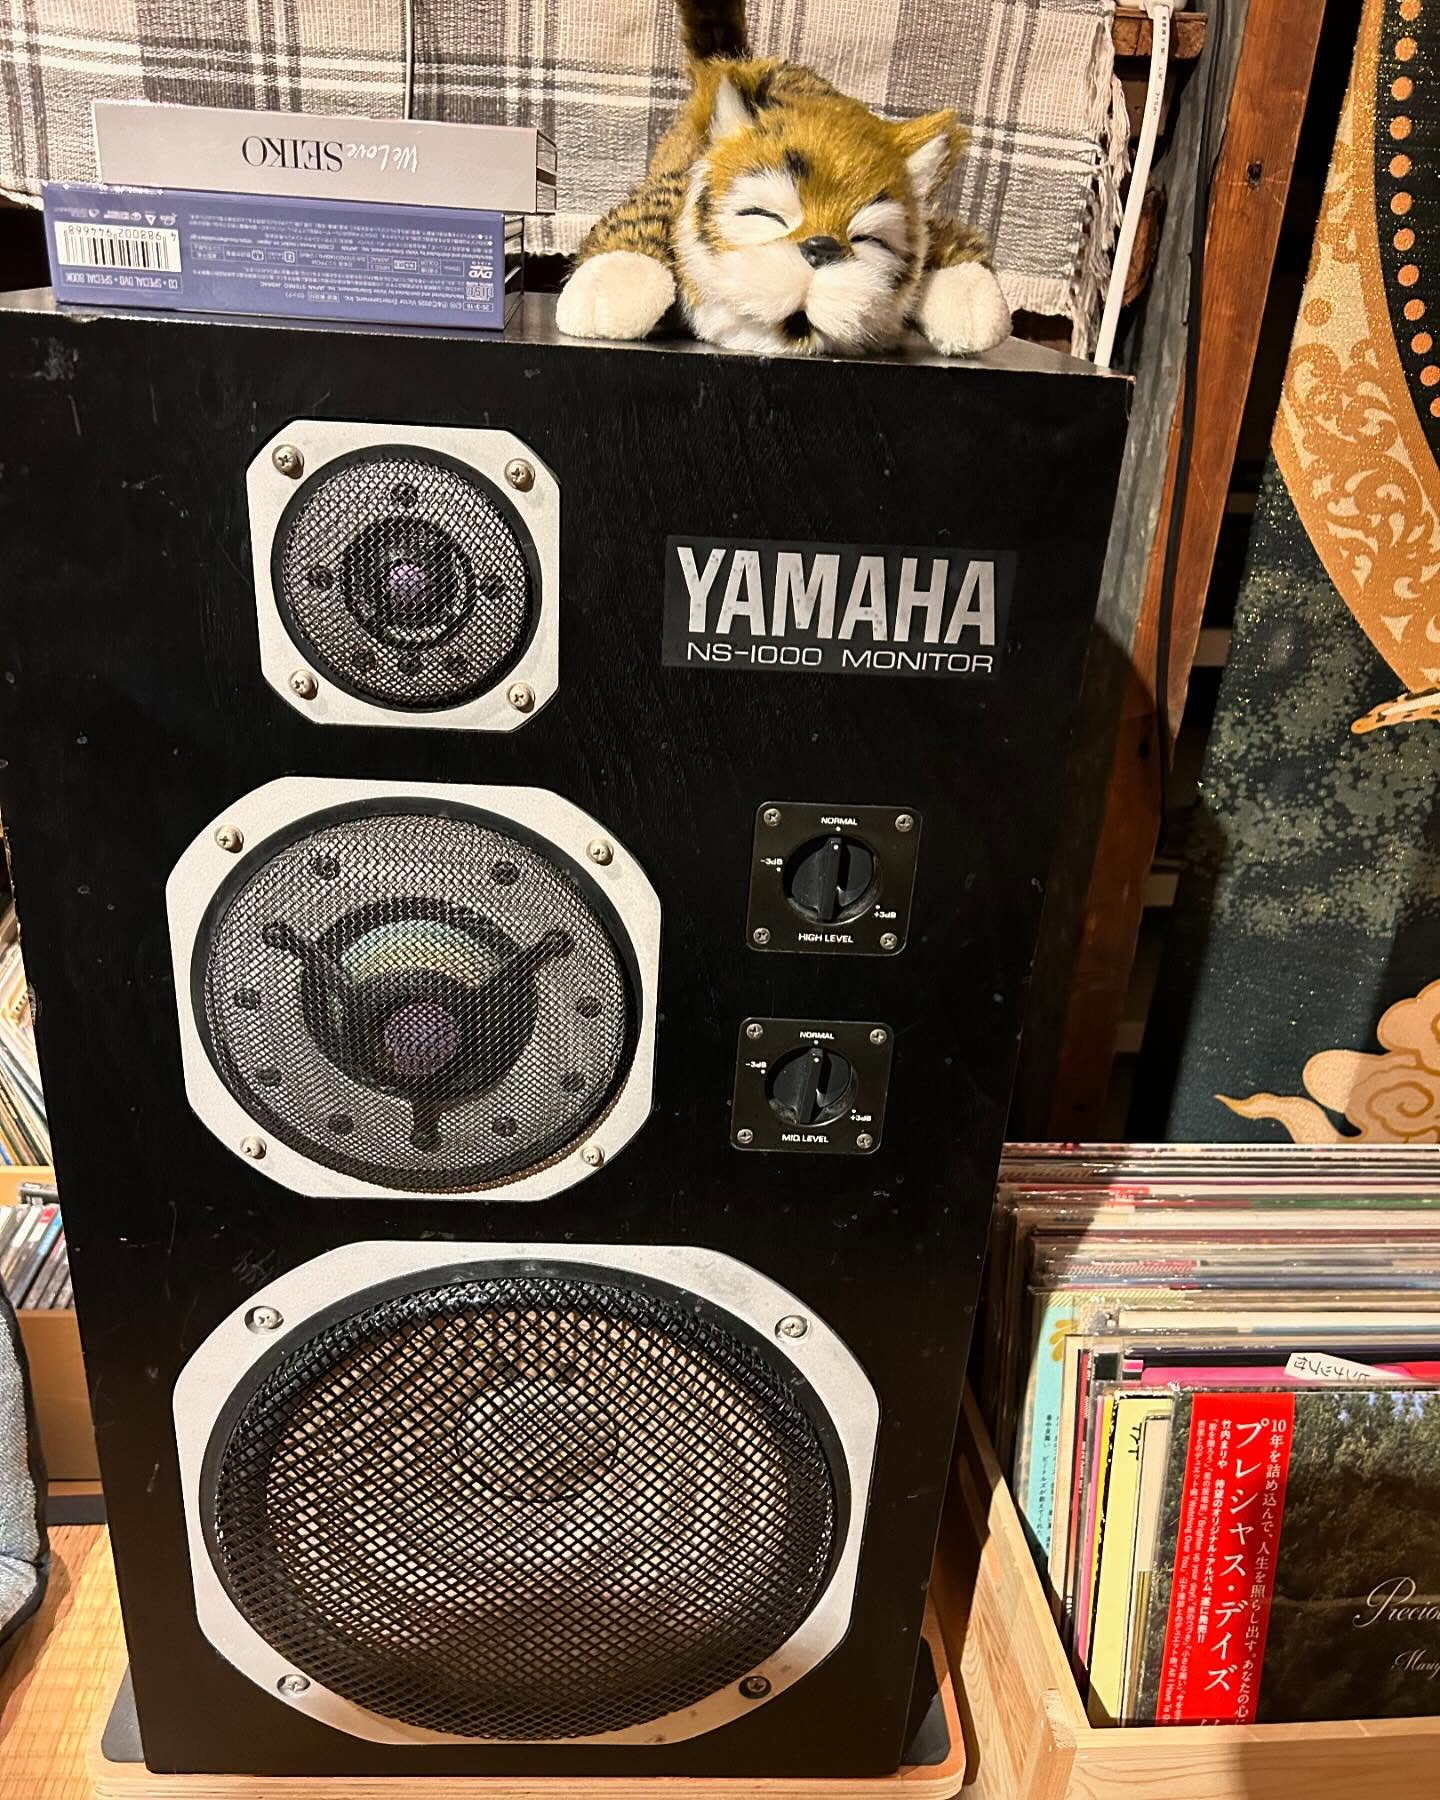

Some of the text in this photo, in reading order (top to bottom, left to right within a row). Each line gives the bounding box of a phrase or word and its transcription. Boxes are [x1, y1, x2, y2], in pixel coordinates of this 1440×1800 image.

[242, 136, 418, 173] We Love SEIKO
[68, 225, 176, 241] 4 988002 944668
[65, 272, 84, 282] BOOK
[85, 273, 112, 284] SPECIAL
[119, 276, 133, 285] DVD
[135, 276, 162, 288] SPECIAL
[168, 279, 178, 289] CD
[677, 546, 995, 646] YAMAHA
[687, 642, 994, 673] NS-1000 MONITOR
[821, 816, 858, 826] NORMAL
[874, 910, 897, 919] +3dB
[798, 932, 854, 944] HIGH LEVEL
[800, 1031, 834, 1040] NORMAL
[850, 1114, 872, 1122] +3dB
[801, 1134, 829, 1144] LEVEL
[1217, 1419, 1232, 1470] 竹内まりや
[1184, 1536, 1192, 1552] Over
[1204, 1418, 1269, 1691] プレシャス・デイズ
[1165, 1684, 1173, 1702] Have
